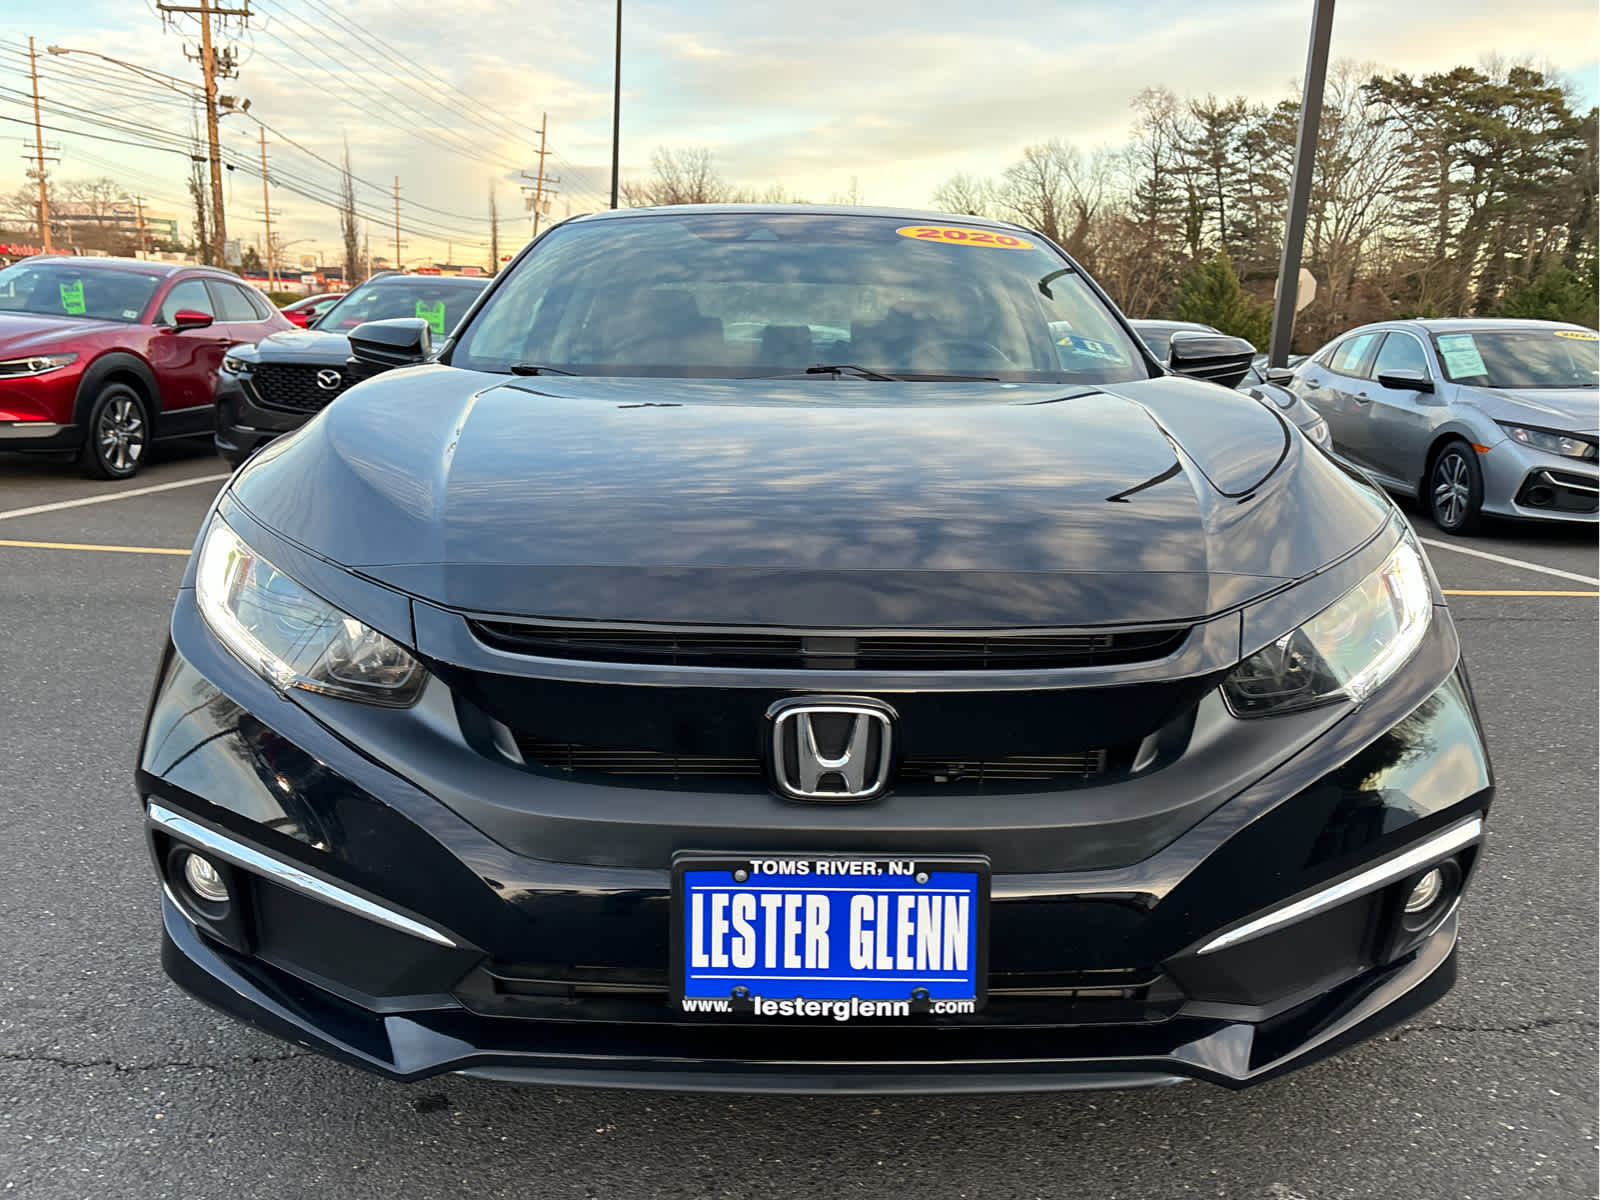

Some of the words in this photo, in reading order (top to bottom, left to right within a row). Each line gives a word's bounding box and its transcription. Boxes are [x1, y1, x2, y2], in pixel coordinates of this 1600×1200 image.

[917, 228, 1019, 245] 2020
[750, 860, 810, 875] TOMS
[816, 859, 883, 877] RIVER,
[888, 860, 916, 876] NJ
[691, 893, 831, 969] LESTER
[849, 894, 970, 971] GLENN
[754, 997, 912, 1022] lesterglenn
